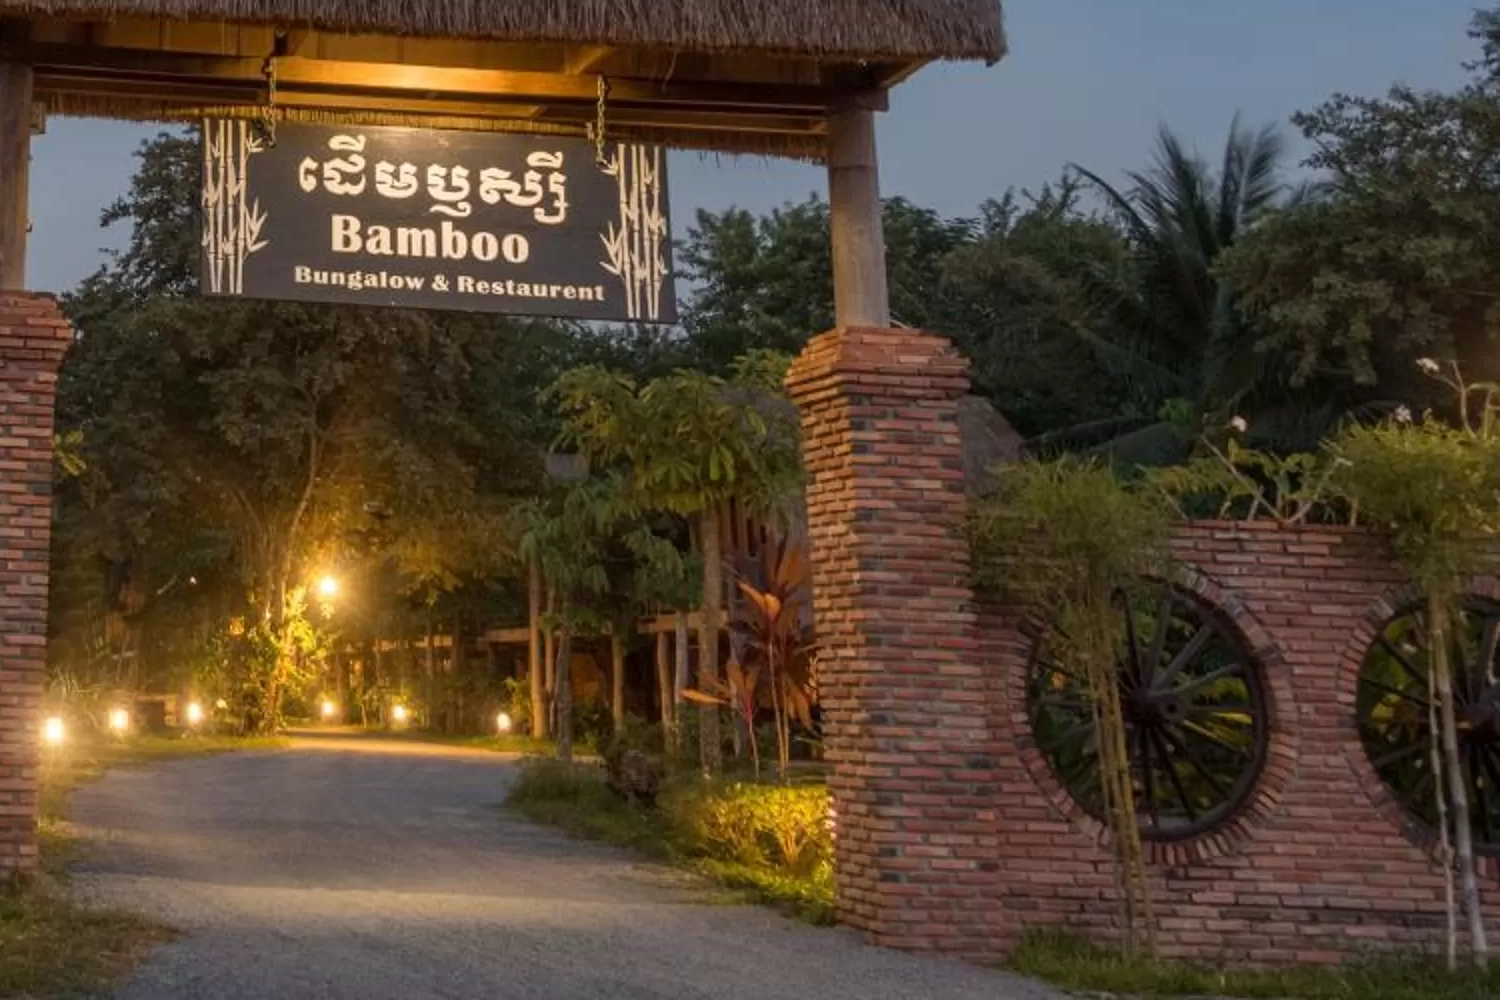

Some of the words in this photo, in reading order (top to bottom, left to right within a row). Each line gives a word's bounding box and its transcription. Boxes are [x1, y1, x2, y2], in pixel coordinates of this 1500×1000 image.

[331, 214, 530, 264] Bamboo
[295, 265, 425, 291] Bungalow
[431, 274, 449, 291] &
[457, 275, 605, 301] Restaurent
